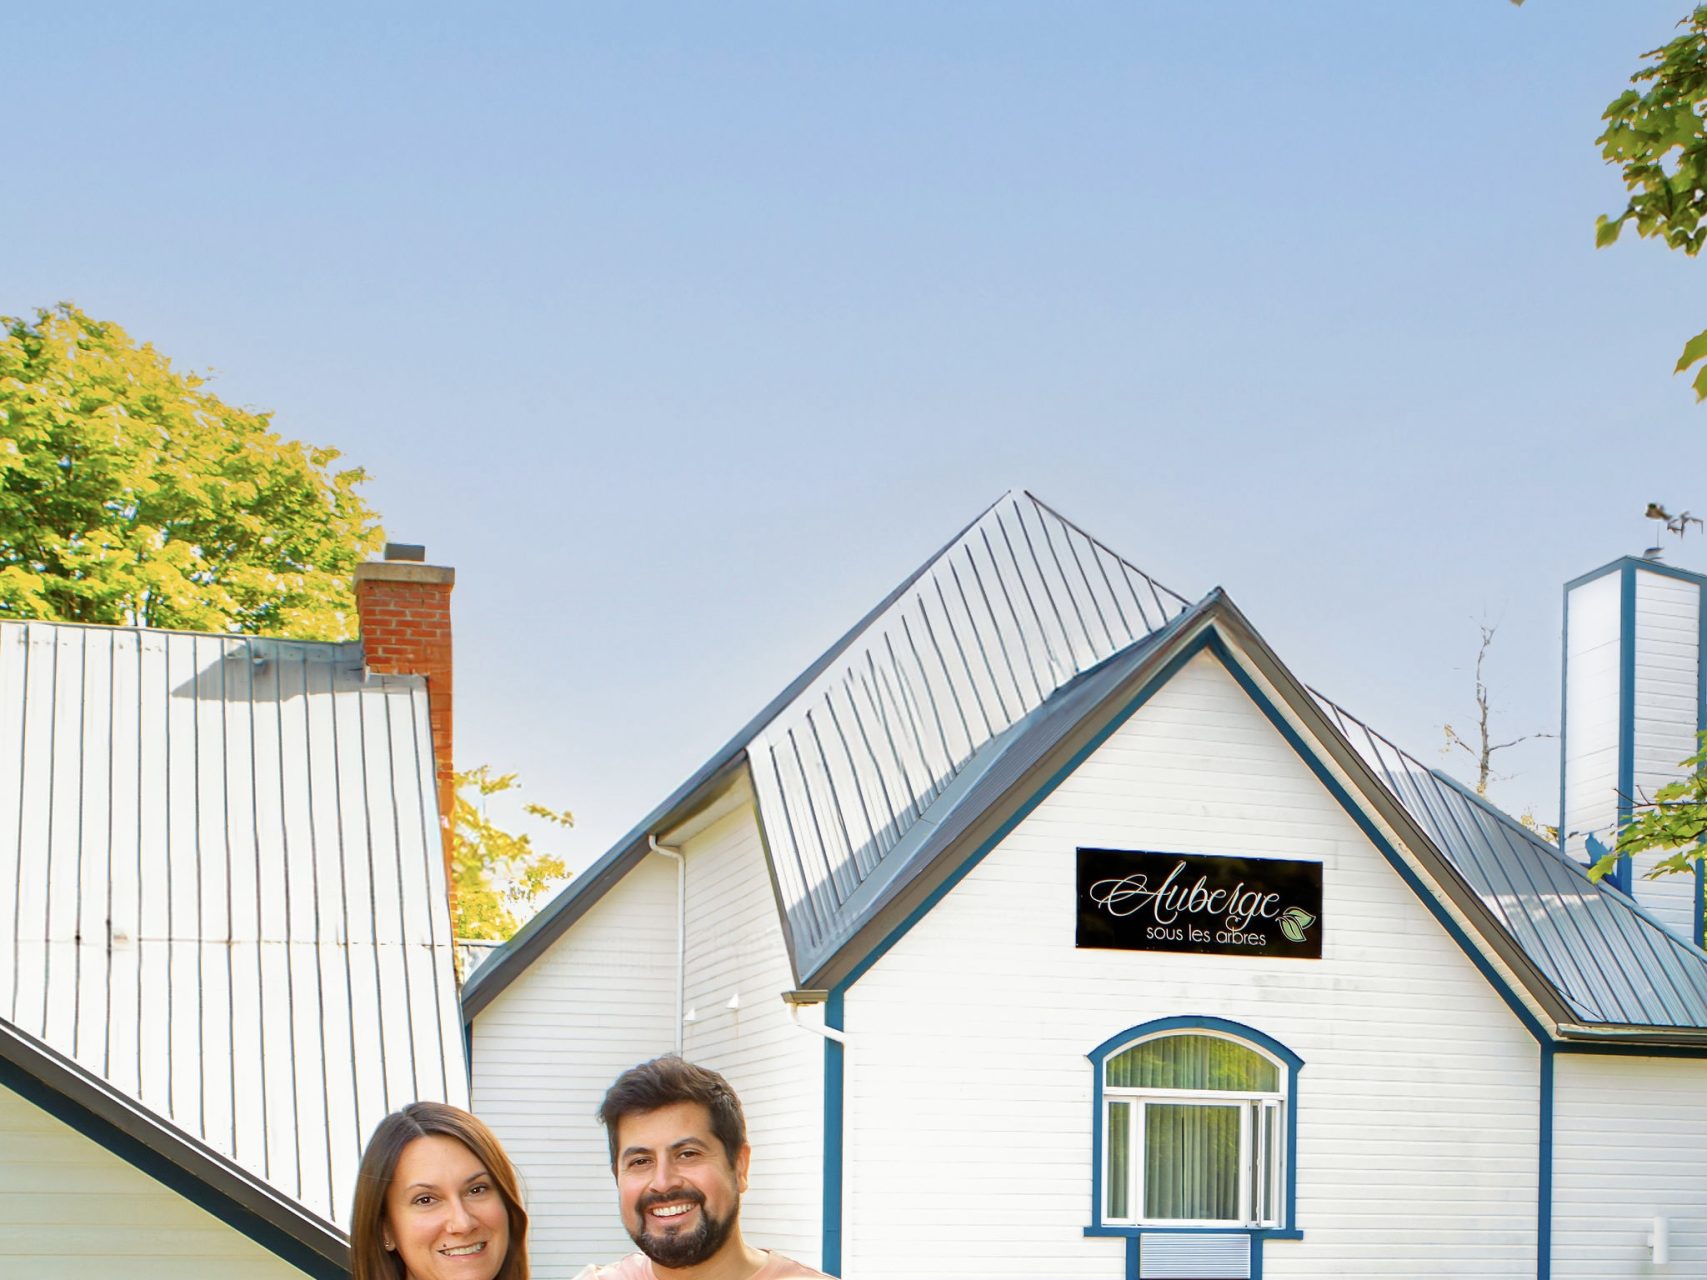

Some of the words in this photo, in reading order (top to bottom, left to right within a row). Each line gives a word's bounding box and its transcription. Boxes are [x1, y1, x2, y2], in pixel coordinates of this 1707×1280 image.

[1090, 860, 1279, 931] Auberge
[1146, 926, 1183, 941] sous
[1188, 924, 1211, 943] les
[1216, 926, 1266, 946] arbres
